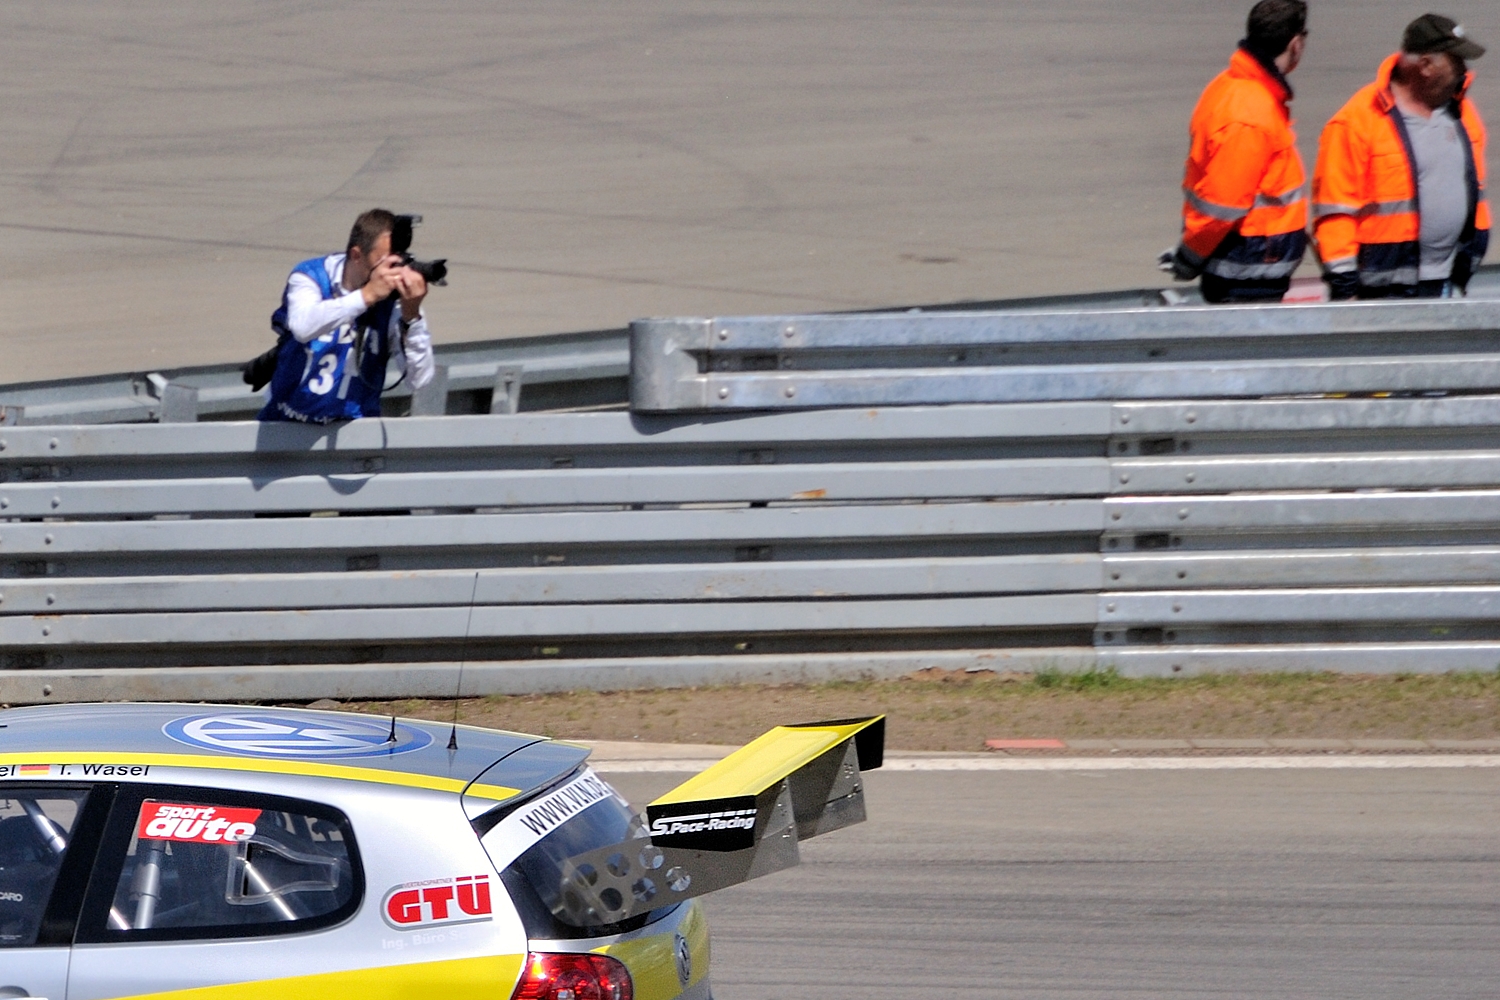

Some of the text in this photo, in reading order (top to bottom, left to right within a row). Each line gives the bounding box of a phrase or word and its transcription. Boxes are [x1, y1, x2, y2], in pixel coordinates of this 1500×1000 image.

[57, 764, 150, 776] T. Wasel
[155, 805, 217, 820] sport
[145, 818, 256, 841] auto
[387, 875, 492, 924] GTÜ
